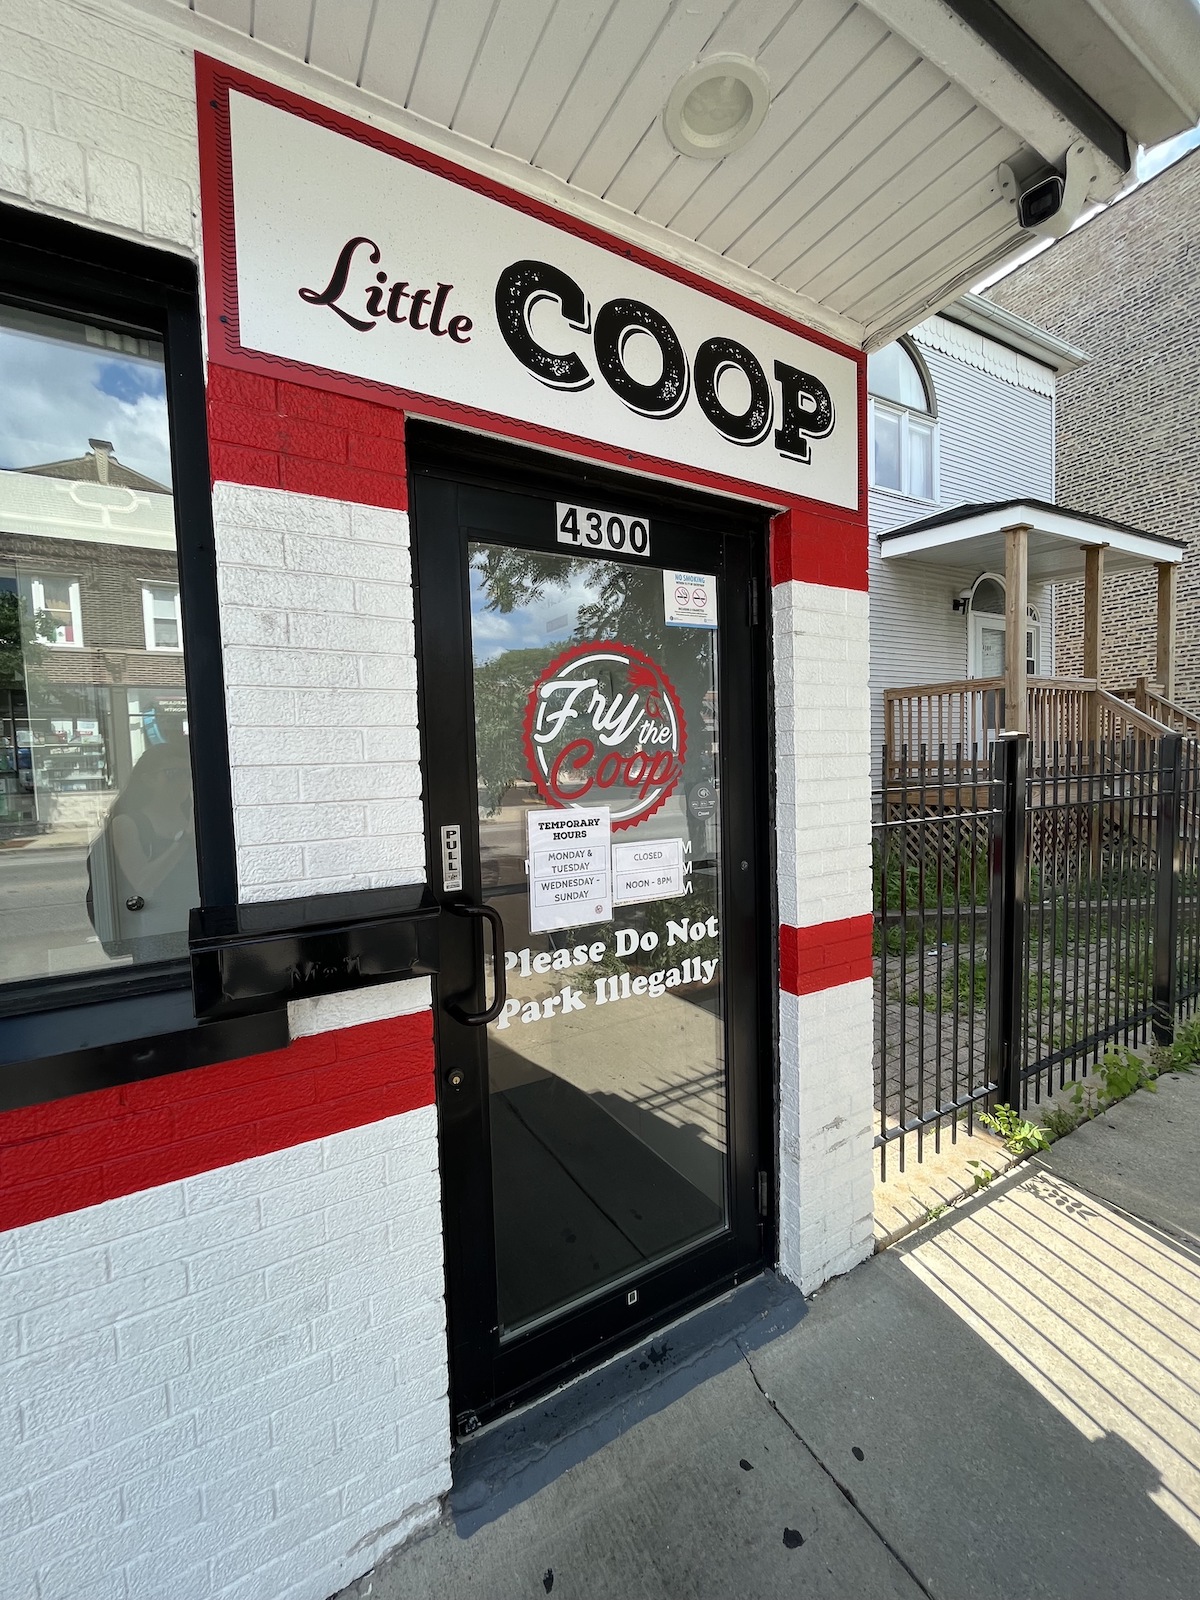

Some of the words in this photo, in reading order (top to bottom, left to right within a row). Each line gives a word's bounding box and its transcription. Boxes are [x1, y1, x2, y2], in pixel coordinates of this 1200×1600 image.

[298, 236, 473, 344] Little
[494, 259, 836, 466] COOP
[559, 507, 649, 554] 4300
[675, 573, 683, 581] NO
[683, 574, 705, 583] SMOKING
[533, 677, 646, 746] Fry
[638, 718, 673, 745] the
[550, 738, 680, 800] Coop
[538, 818, 601, 831] TEMPORARY
[552, 830, 587, 841] HOURS
[445, 830, 458, 871] PULL
[548, 849, 586, 862] MONDAY
[586, 849, 593, 857] &
[633, 851, 663, 862] CLOSED
[551, 862, 590, 874] TUESDAY
[541, 877, 595, 891] WEDNESDAY
[625, 879, 650, 889] NOON
[656, 876, 672, 886] 8PM
[554, 890, 590, 902] SUNDAY
[614, 928, 659, 957] Do
[666, 915, 719, 946] Not
[496, 985, 587, 1030] Park
[594, 955, 719, 1006] Illegally
